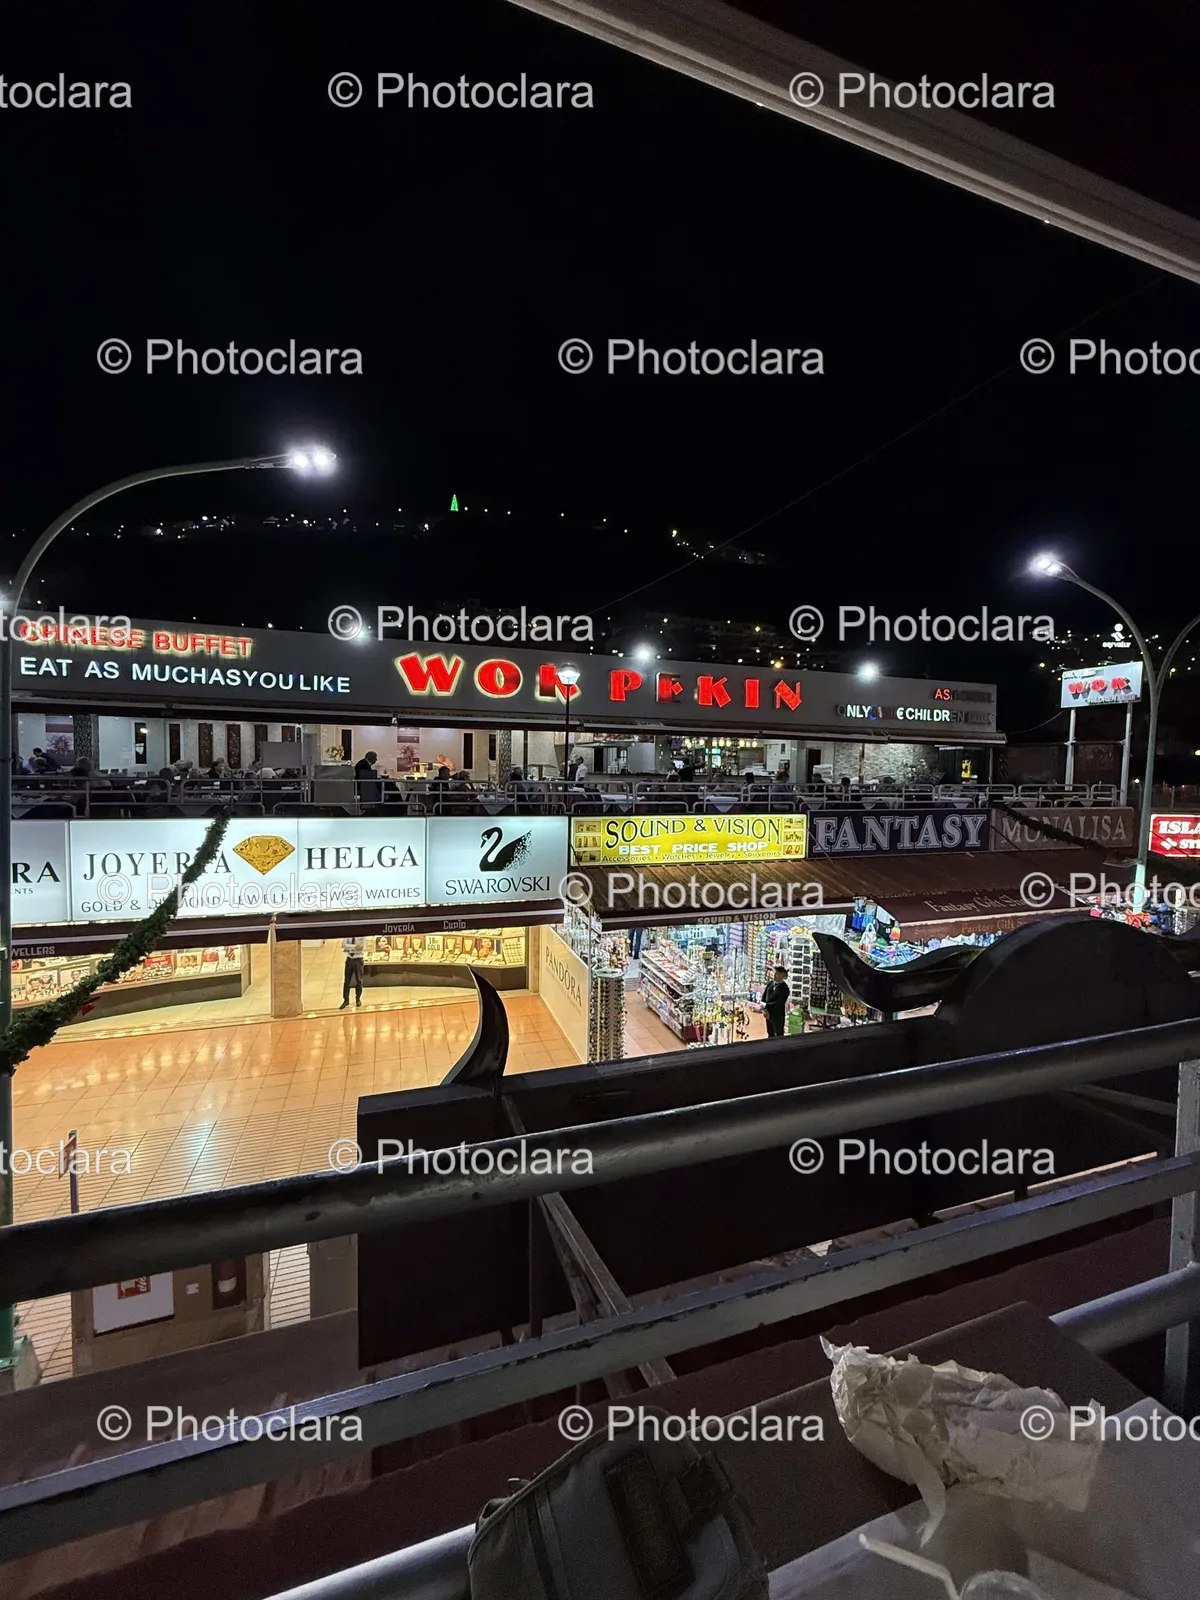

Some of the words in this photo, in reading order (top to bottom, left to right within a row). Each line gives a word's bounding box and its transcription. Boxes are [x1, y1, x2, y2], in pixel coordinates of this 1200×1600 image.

[20, 621, 144, 649] CHINESE
[154, 631, 252, 656] BUFFET
[20, 656, 73, 677] EAT
[84, 660, 120, 679] AS
[395, 652, 582, 703] WOK
[609, 668, 803, 711] PEKIN
[1067, 677, 1131, 699] WOK
[605, 819, 686, 849] SOUND
[694, 819, 707, 832] &
[713, 818, 781, 850] VISION
[813, 814, 987, 852] FANTASY
[602, 854, 651, 863] Accessories
[661, 853, 696, 861] Watches
[743, 850, 781, 858] Souvenirs
[619, 844, 661, 855] BEST
[672, 842, 718, 854] PRICE
[727, 841, 769, 853] SHOP
[83, 851, 232, 881] JOYERA
[304, 845, 420, 870] HELGA
[445, 876, 551, 896] SWAROVSKI
[81, 900, 123, 913] GOLD
[130, 899, 141, 911] &
[365, 887, 420, 900] WATCHES
[923, 899, 978, 913] Fantasy
[697, 916, 732, 925] SOUND
[743, 913, 777, 921] VISION
[961, 920, 997, 933] Fantasy
[545, 946, 582, 1007] PANDORA
